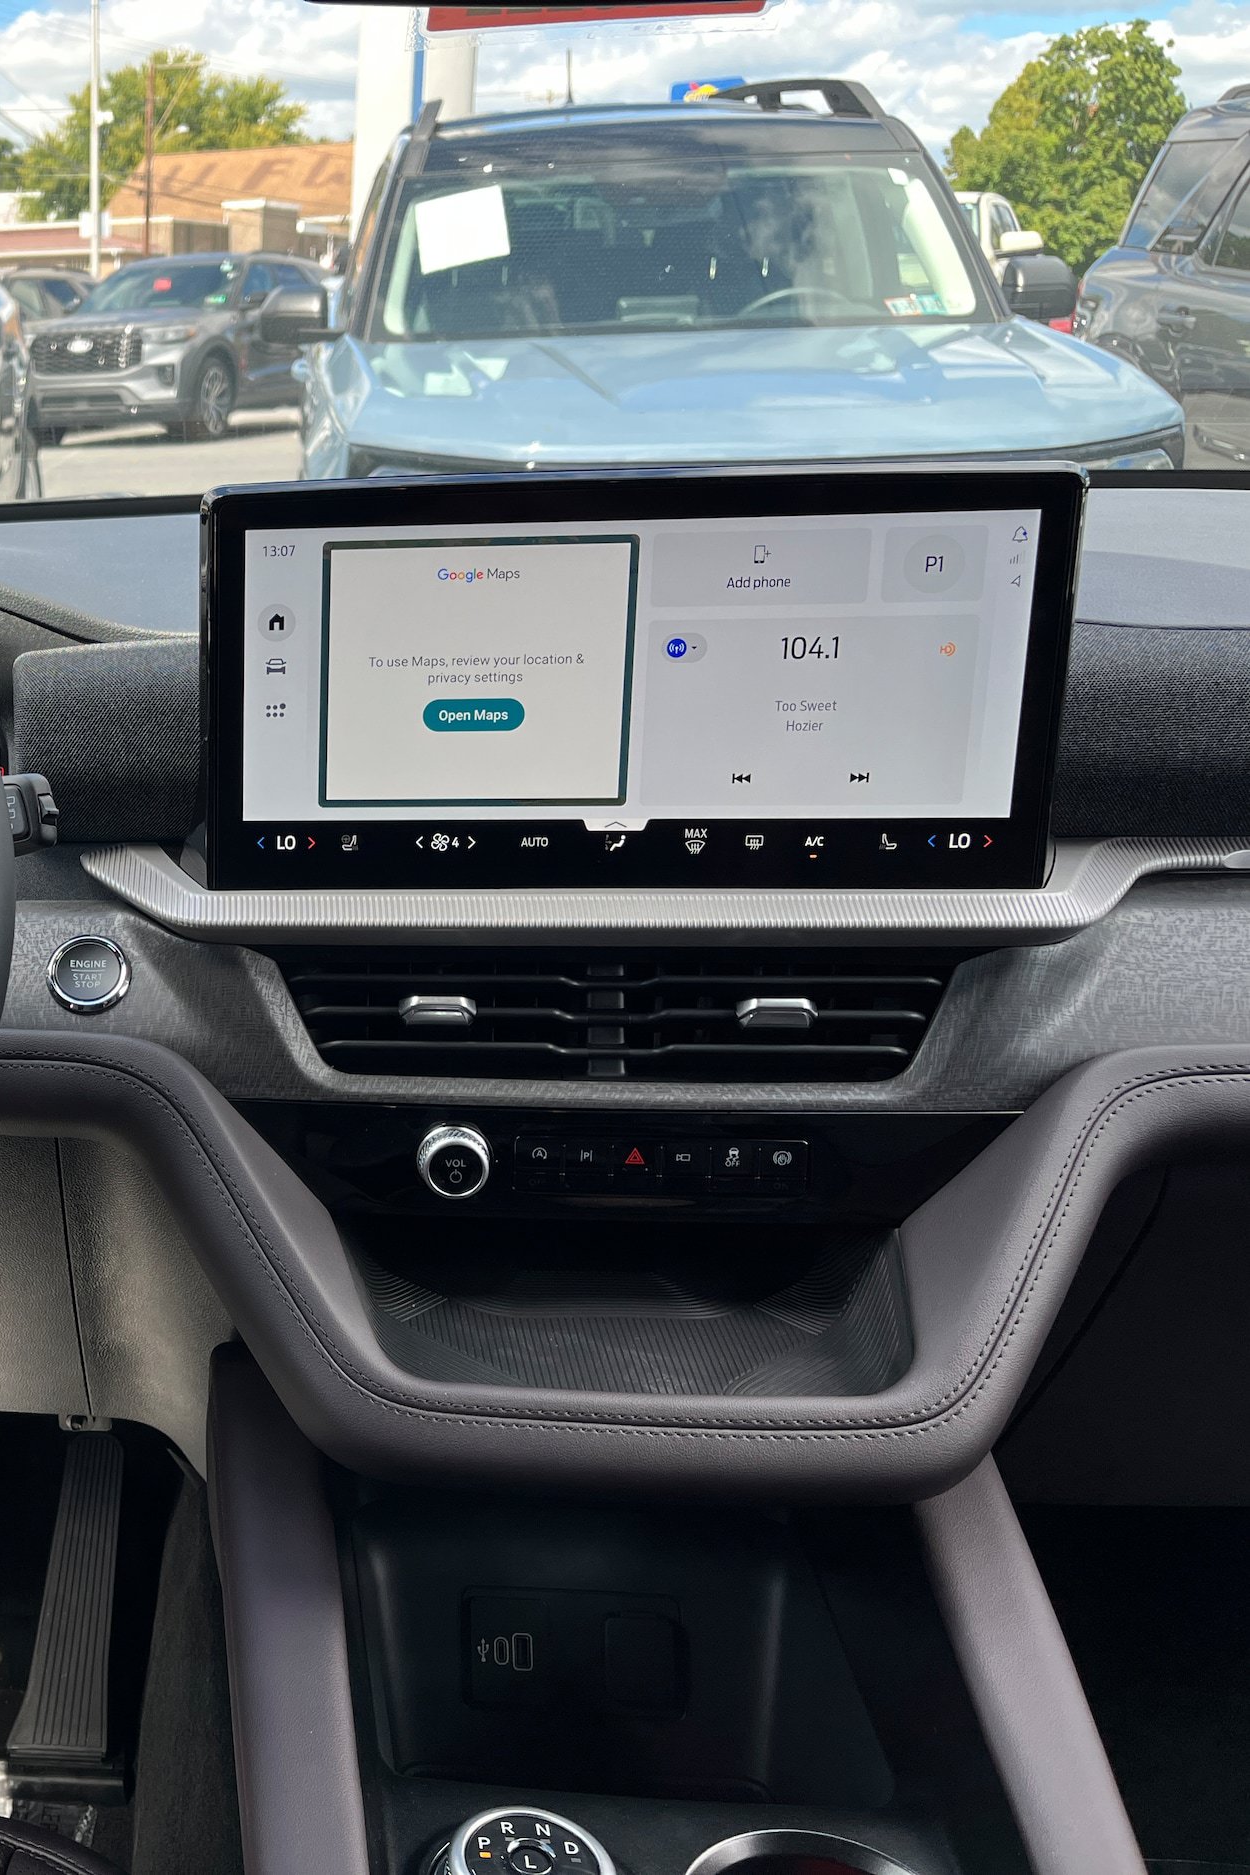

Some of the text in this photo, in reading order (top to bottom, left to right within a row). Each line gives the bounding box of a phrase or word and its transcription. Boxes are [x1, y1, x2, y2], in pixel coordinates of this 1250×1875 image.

[262, 545, 296, 558] 13:07
[924, 556, 945, 573] P1
[437, 567, 521, 583] Google Maps
[726, 575, 791, 590] Add phone
[780, 636, 841, 660] 104.1
[369, 653, 585, 670] To use Maps, review your location &
[427, 671, 523, 686] privacy settings
[775, 700, 838, 712] Too Sweet
[438, 708, 509, 723] Open Maps
[785, 720, 824, 732] Hozier
[684, 828, 708, 839] MAX
[276, 834, 297, 850] LO
[451, 836, 459, 848] 4
[520, 837, 549, 848] AUTO
[804, 835, 825, 848] A/C
[948, 833, 971, 849] LO
[70, 959, 107, 968] ENGINE
[72, 973, 103, 981] START
[74, 981, 101, 989] STOP
[444, 1158, 467, 1169] VOL
[724, 1160, 741, 1168] OFF
[500, 1821, 516, 1835] R
[535, 1823, 551, 1837] N
[477, 1836, 491, 1850] P
[563, 1841, 579, 1855] D
[523, 1855, 538, 1869] L
